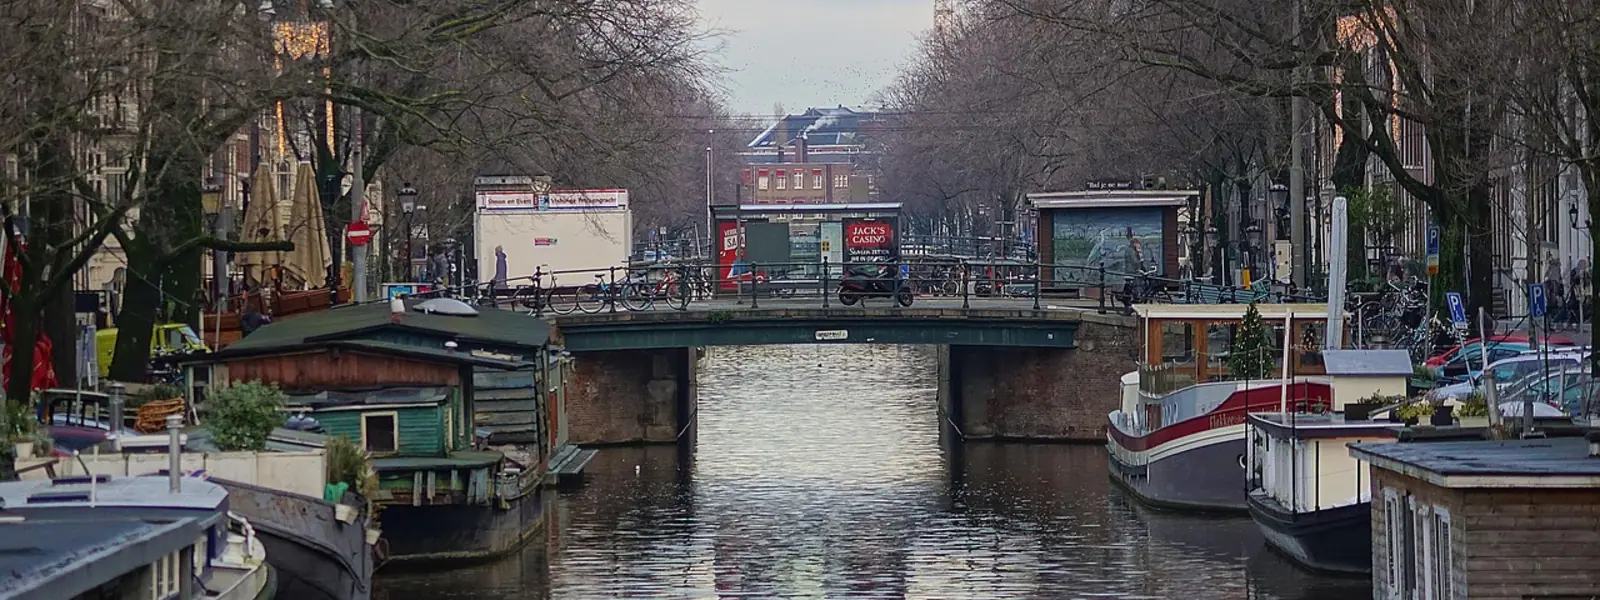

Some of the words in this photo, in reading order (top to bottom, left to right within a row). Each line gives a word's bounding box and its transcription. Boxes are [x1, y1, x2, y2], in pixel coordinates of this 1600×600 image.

[852, 227, 886, 235] JACK'S
[1430, 229, 1437, 244] P
[852, 235, 886, 243] CASINO
[1450, 295, 1459, 311] P
[1533, 287, 1541, 304] P
